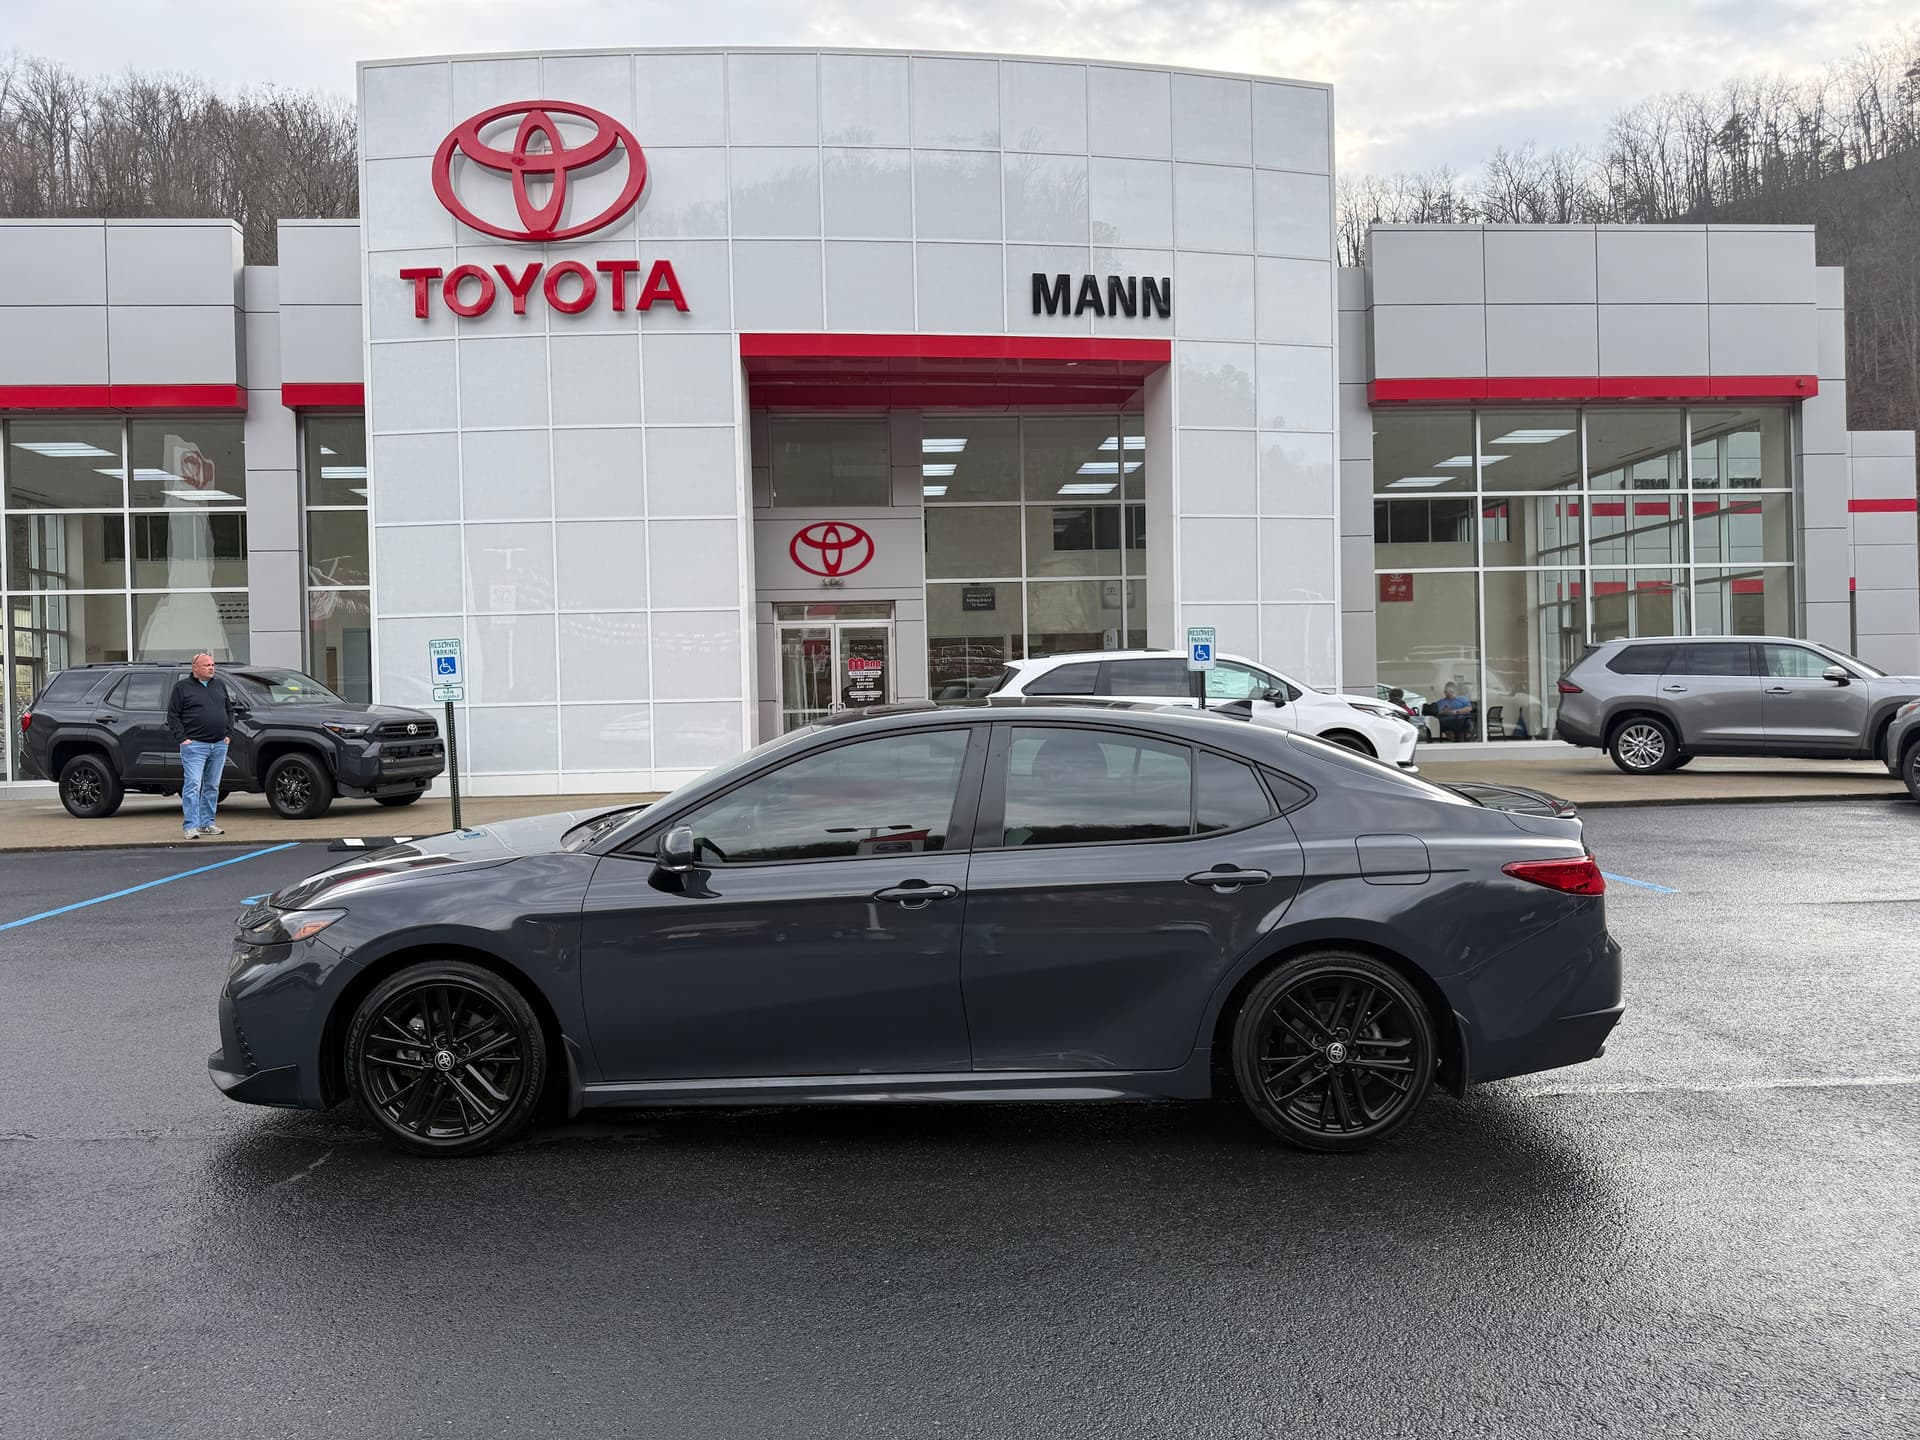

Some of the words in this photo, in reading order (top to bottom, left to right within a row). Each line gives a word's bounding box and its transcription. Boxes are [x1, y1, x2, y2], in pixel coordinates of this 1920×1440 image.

[399, 259, 690, 319] TOYOTA
[1032, 272, 1171, 319] MANN
[433, 648, 458, 656] PARKING
